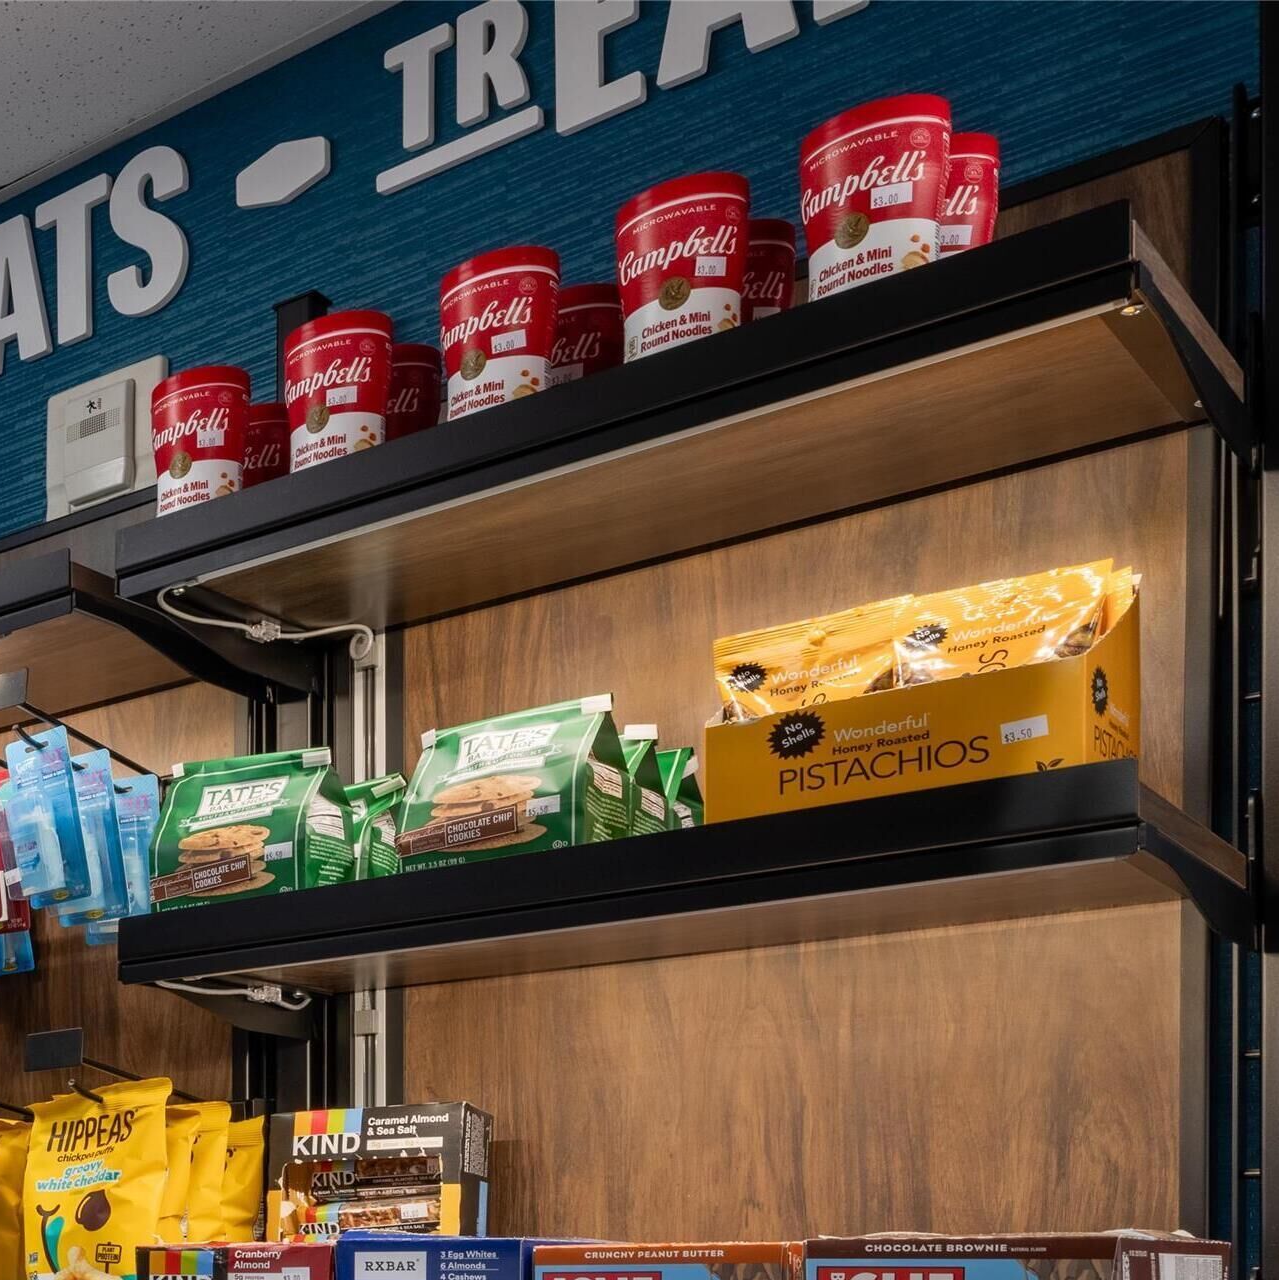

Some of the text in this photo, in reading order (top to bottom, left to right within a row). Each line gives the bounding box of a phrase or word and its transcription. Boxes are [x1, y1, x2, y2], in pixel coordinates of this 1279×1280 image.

[809, 131, 899, 172] MICROWAVABLE
[802, 151, 926, 225] Campbell's
[874, 194, 899, 207] $3.00
[633, 204, 717, 235] MICROWAVABLE
[619, 225, 738, 287] Campbell's
[819, 246, 892, 283] Chicken Mini
[817, 261, 894, 297] Round Noodles
[443, 279, 510, 311] MICROWAVABLE
[642, 311, 711, 339] Chicken Mini
[641, 325, 713, 353] Round Noodles
[483, 380, 504, 393] Mini
[468, 394, 505, 410] Noodles
[327, 434, 347, 446] Mini
[313, 447, 348, 461] Noodles
[947, 625, 1046, 654] Honey Roasted
[771, 657, 858, 684] Wonderful
[770, 682, 807, 697] Honey
[784, 721, 803, 735] No
[834, 713, 928, 743] Wonderful
[1004, 728, 1032, 743] $3.50
[464, 725, 554, 756] TATE'S
[781, 727, 816, 749] Shells
[832, 730, 930, 756] Honey Roasted
[779, 735, 991, 795] PISTACHIOS
[207, 782, 283, 807] TATE'S
[447, 811, 513, 835] CHOCOLATE CHIP
[447, 829, 481, 845] COOKIES
[193, 860, 247, 881] CHOCOLATE CHIP
[195, 874, 222, 889] COOKIES
[368, 1113, 449, 1127] Caramel Almond
[46, 1110, 135, 1153] HIPPEAS
[376, 1125, 417, 1136] Sea Salt
[293, 1133, 361, 1156] KIND
[57, 1151, 94, 1163] chickpea
[64, 1160, 102, 1178] groovy
[37, 1170, 121, 1191] white cheddar
[311, 1171, 356, 1188] KIND
[234, 1250, 281, 1262] Cranberry
[447, 1250, 497, 1260] Egg Whites
[585, 1251, 635, 1259] CRUNCHY
[638, 1250, 679, 1258] PEANUT
[865, 1244, 1008, 1252] CHOCOLATE BROWNIE
[234, 1261, 270, 1270] Almond
[364, 1261, 417, 1272] RXBAR
[447, 1262, 486, 1270] Almonds
[447, 1273, 487, 1280] Cashews
